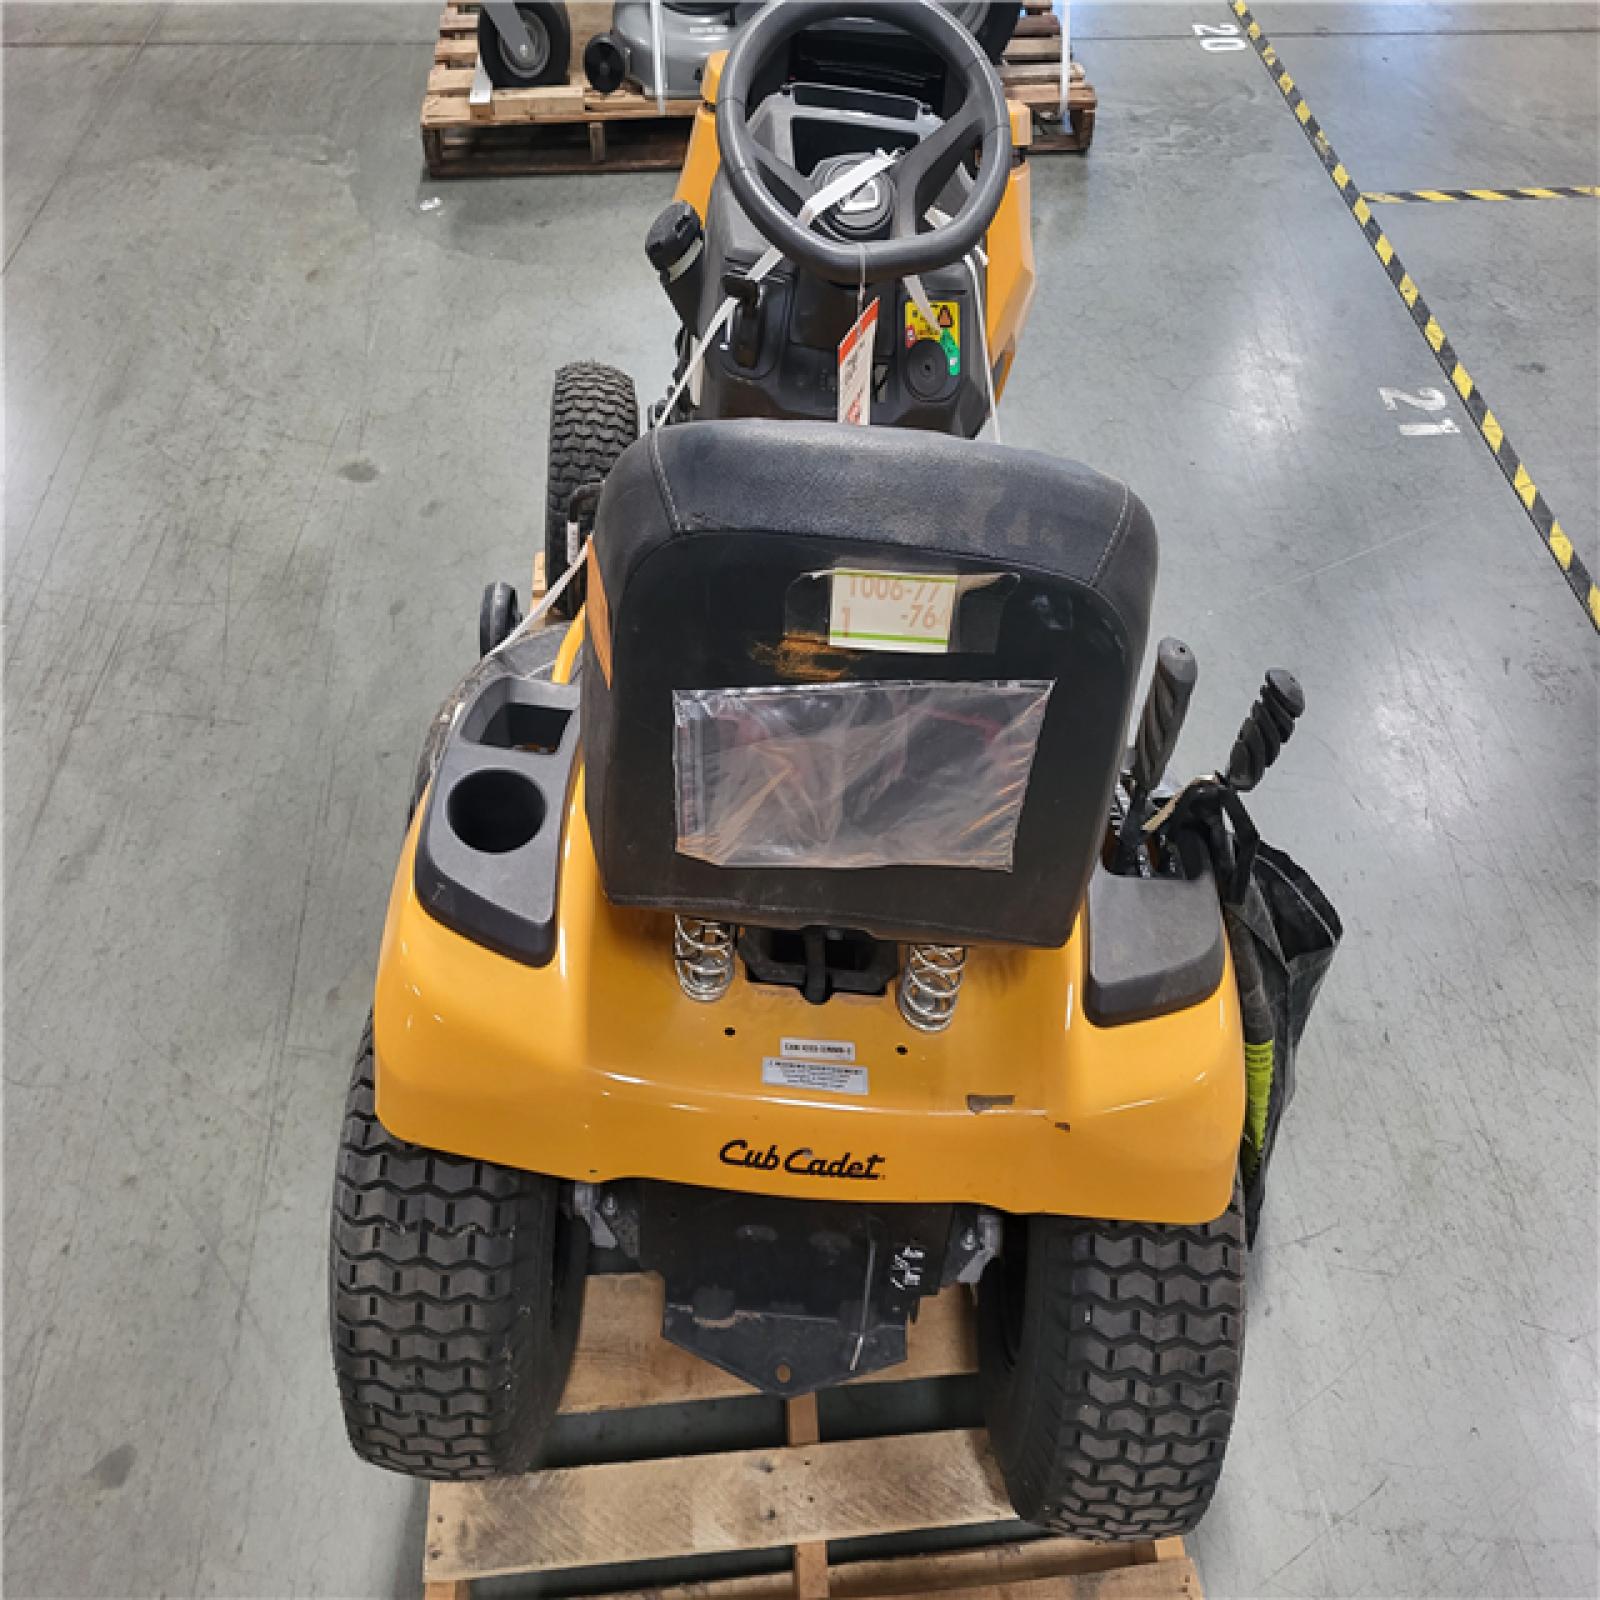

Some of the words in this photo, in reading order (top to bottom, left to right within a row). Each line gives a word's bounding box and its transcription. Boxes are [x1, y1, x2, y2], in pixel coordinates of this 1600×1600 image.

[1191, 22, 1246, 52] 20
[1378, 387, 1461, 436] 21
[719, 1139, 780, 1171] Cub
[784, 1147, 886, 1180] Cadet
